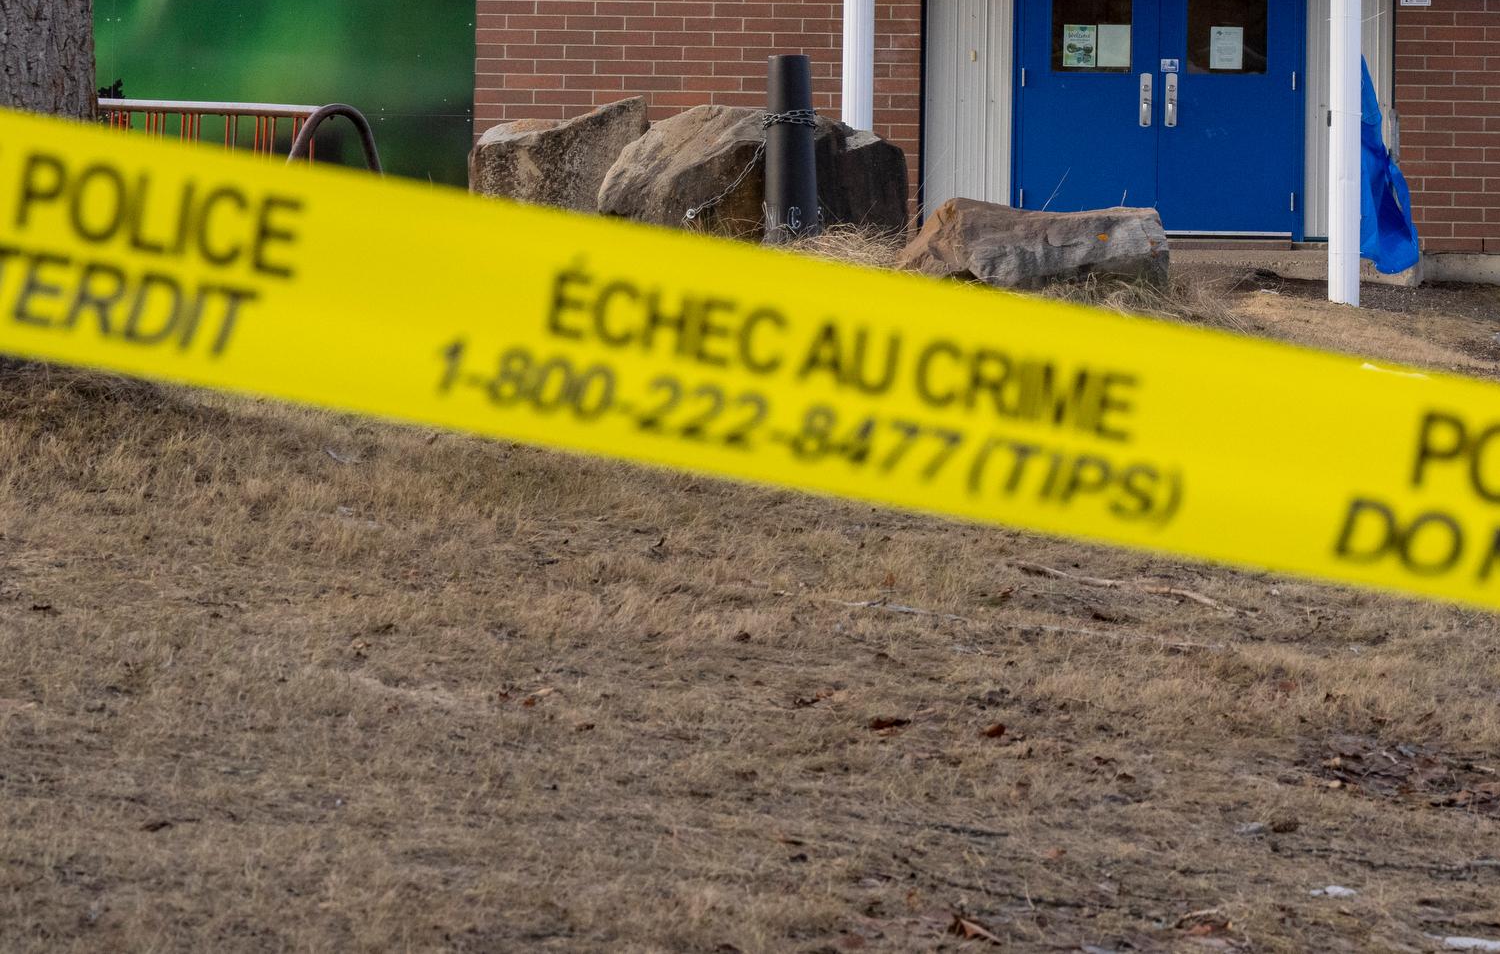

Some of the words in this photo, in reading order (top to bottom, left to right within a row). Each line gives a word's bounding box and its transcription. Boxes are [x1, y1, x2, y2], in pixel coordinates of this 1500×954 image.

[14, 151, 304, 280] POLICE
[546, 258, 786, 375] ÉCHEC
[797, 321, 900, 396] AU
[914, 340, 1136, 442] CRIME
[1332, 496, 1466, 576] DO
